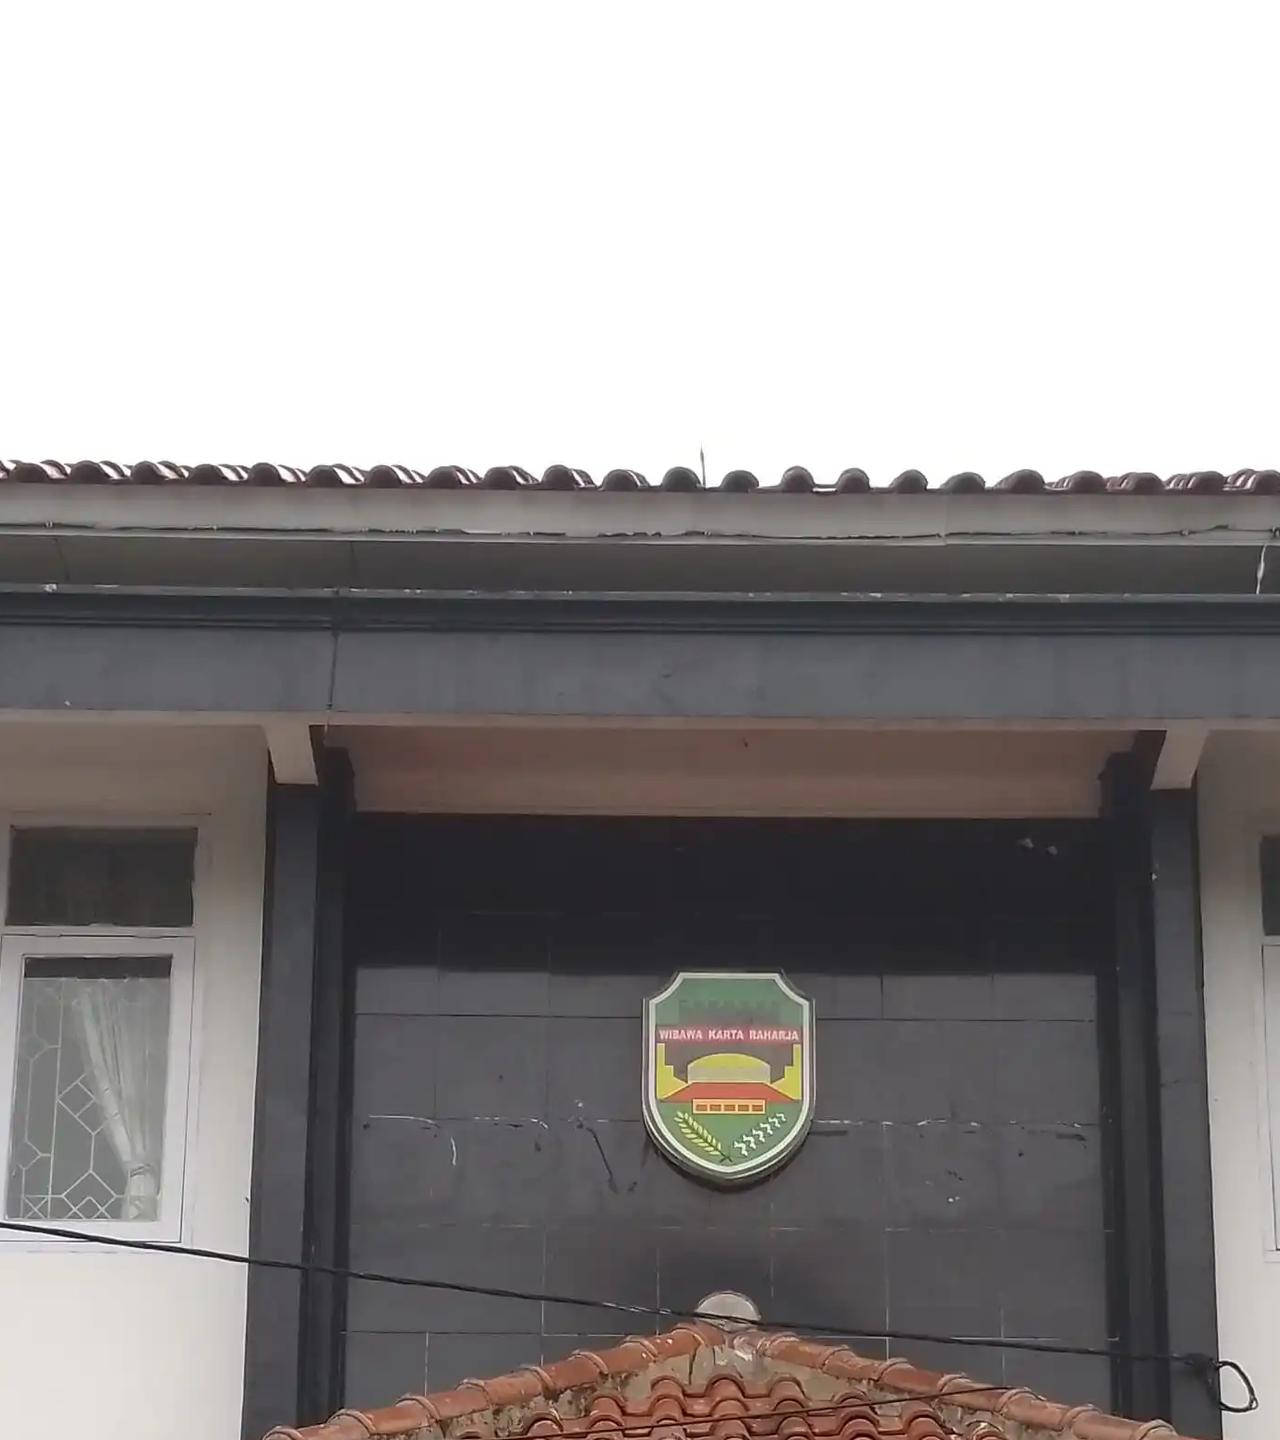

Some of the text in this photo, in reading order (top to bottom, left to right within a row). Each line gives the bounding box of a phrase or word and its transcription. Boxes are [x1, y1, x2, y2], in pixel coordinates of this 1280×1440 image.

[659, 1029, 800, 1041] WIBAWA KARTA RAHARJA
